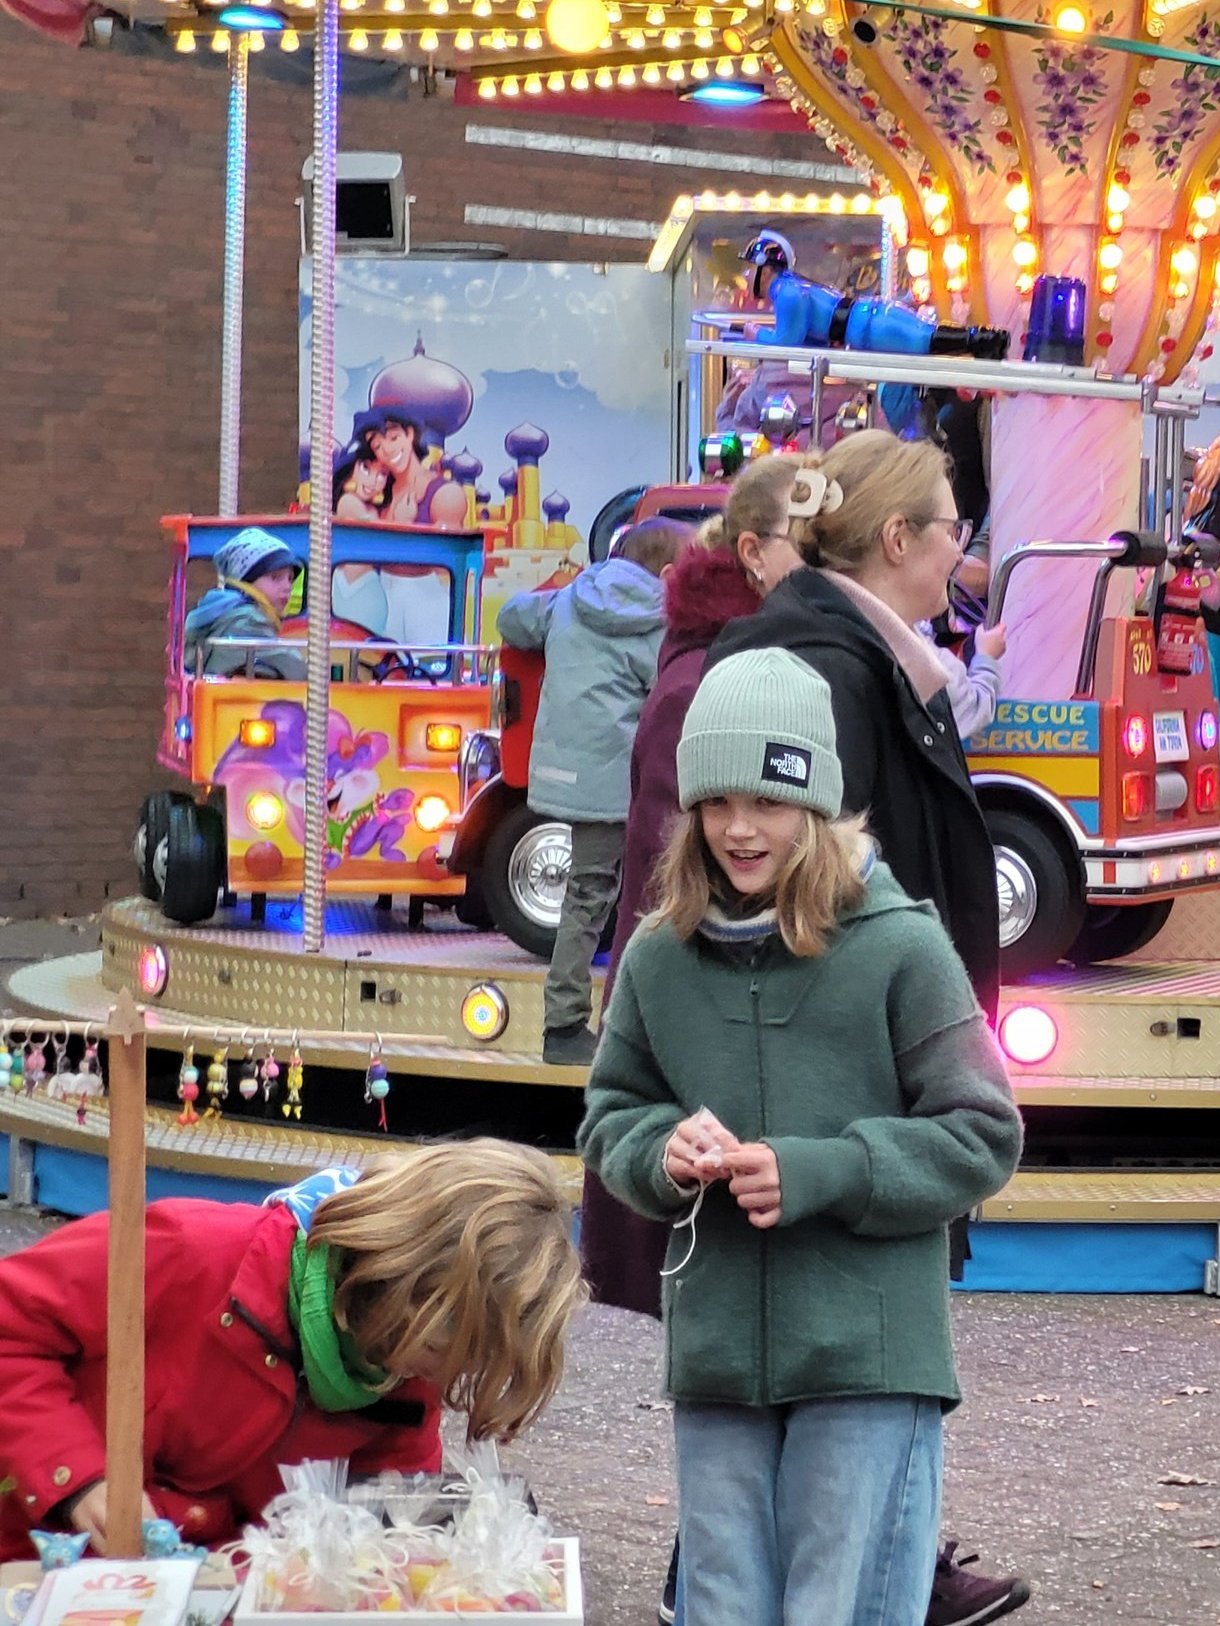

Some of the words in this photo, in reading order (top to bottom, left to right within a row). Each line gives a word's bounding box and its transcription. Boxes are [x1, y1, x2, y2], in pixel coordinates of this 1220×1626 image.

[1132, 642, 1152, 675] 570
[995, 703, 1085, 725] ESCUE
[770, 757, 798, 771] NORTH
[783, 753, 798, 764] THE
[777, 766, 798, 778] FACE
